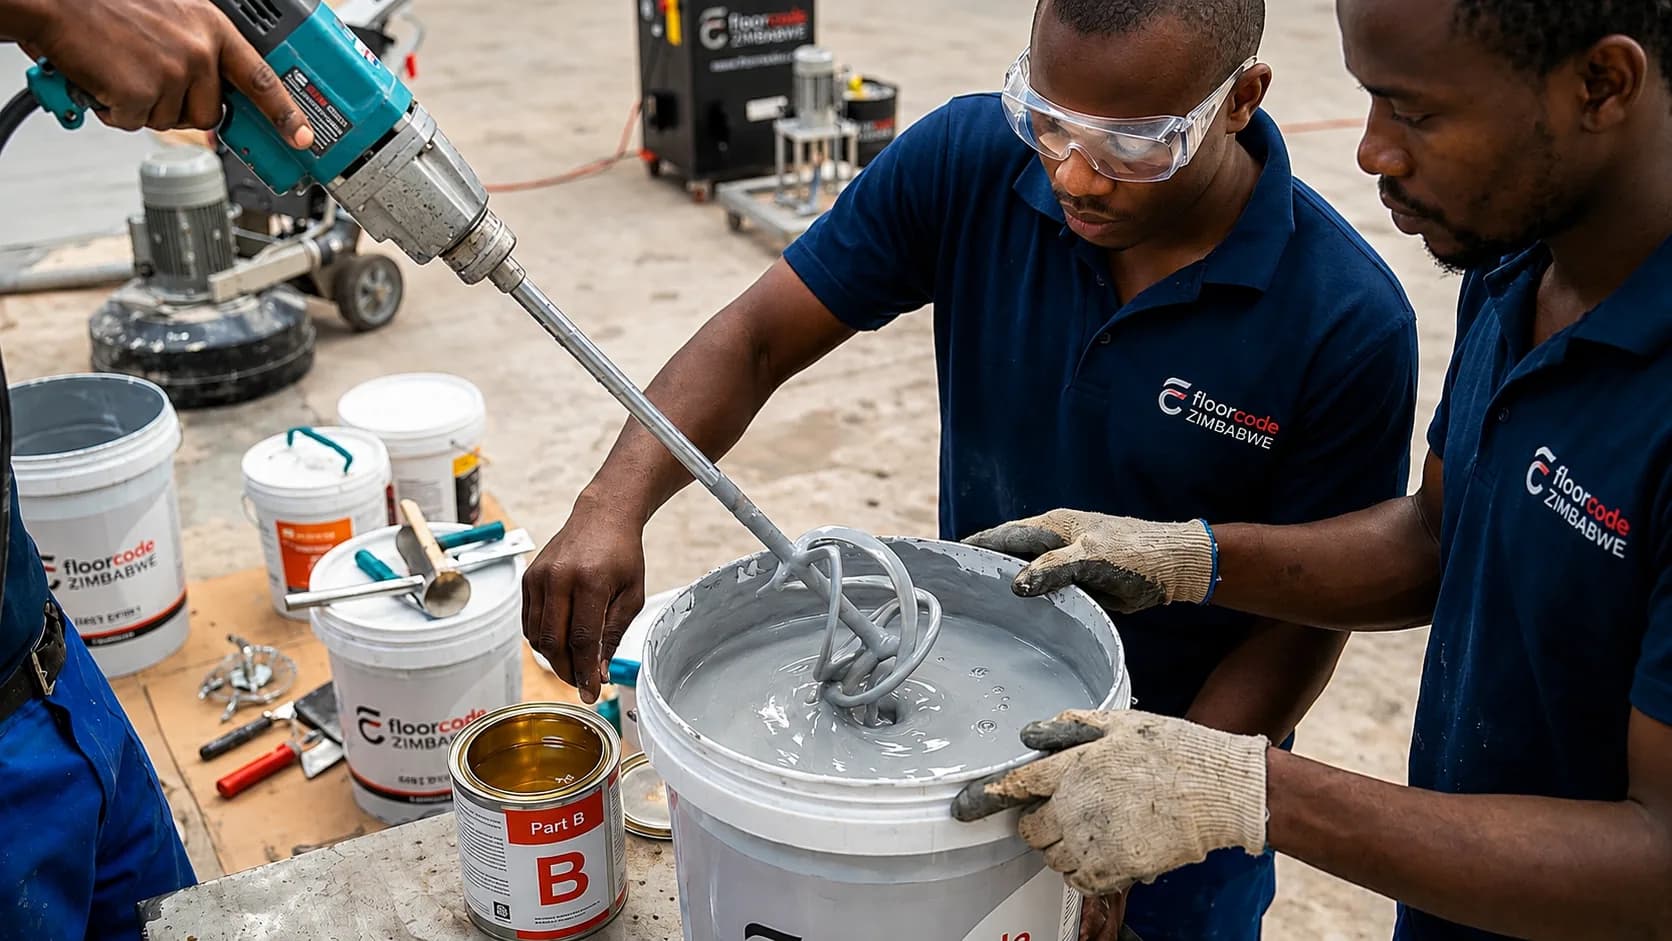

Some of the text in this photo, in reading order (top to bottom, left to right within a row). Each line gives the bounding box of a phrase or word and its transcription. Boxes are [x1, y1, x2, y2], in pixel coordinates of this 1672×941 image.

[1185, 408, 1274, 450] ZIMBABWE
[1192, 390, 1279, 434] floorcode
[1552, 465, 1630, 536] floorcode
[1543, 488, 1627, 558] ZIMBABWE
[64, 540, 155, 575] floorcode
[68, 553, 157, 590] ZIMBABWE
[391, 734, 454, 750] ZIMBA
[530, 811, 585, 836] Part B
[536, 851, 590, 906] B
